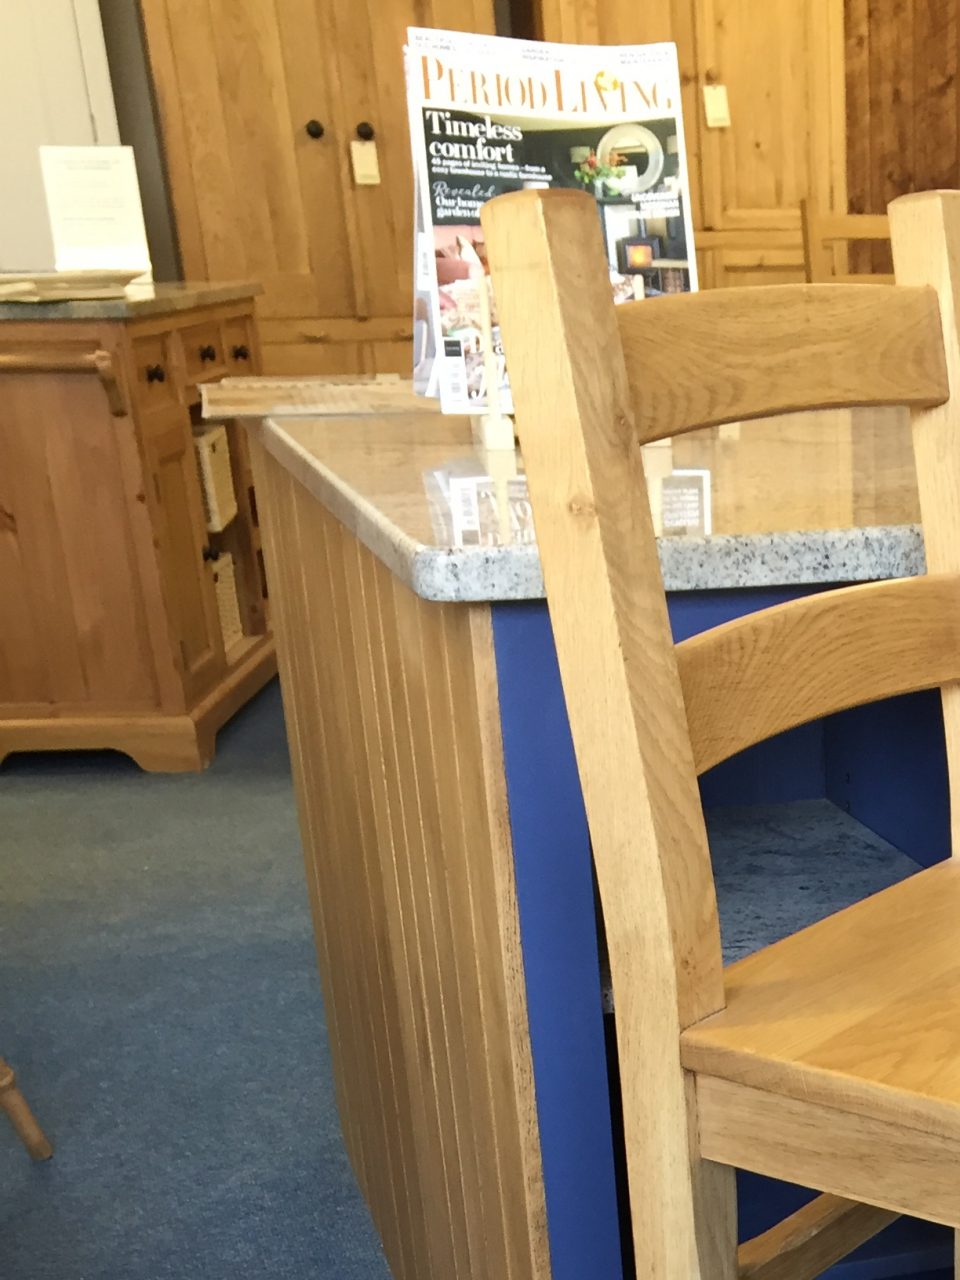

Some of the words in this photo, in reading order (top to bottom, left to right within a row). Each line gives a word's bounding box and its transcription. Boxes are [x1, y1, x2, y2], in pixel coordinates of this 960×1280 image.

[421, 55, 547, 110] PERIOD
[554, 69, 673, 113] LIVING
[425, 110, 523, 141] Timeless
[429, 137, 515, 163] comfort
[432, 180, 496, 198] Revealed
